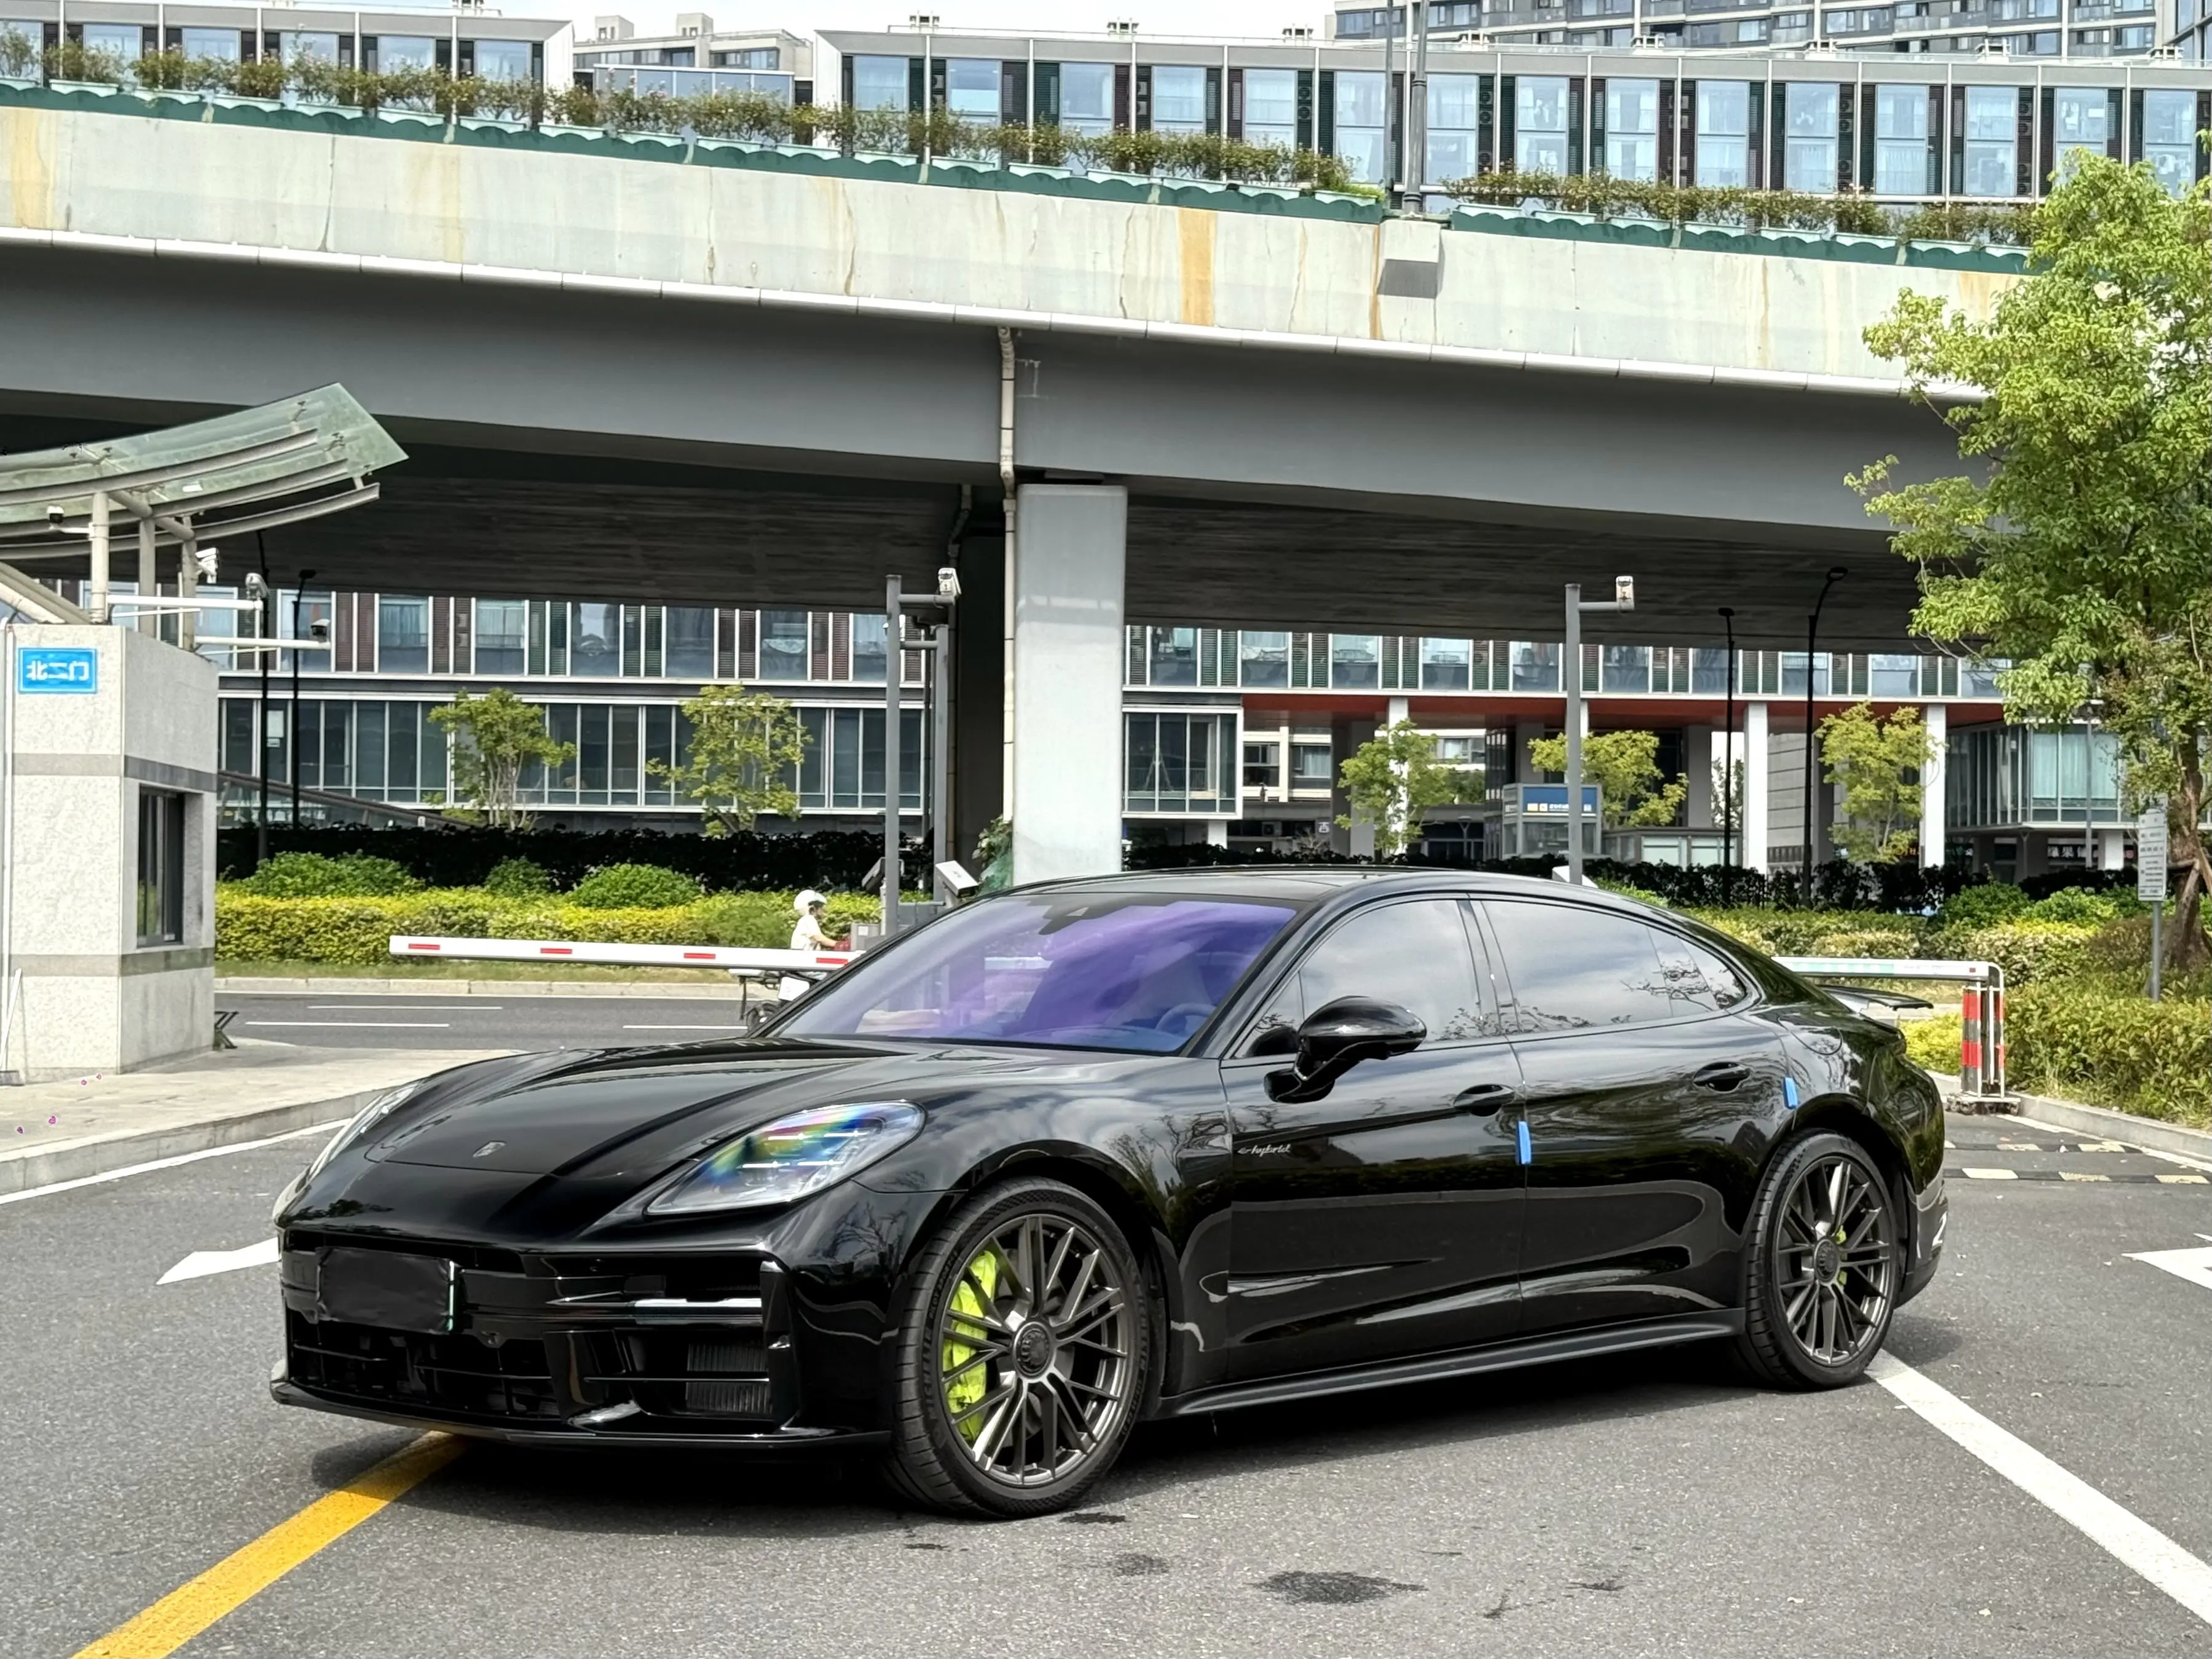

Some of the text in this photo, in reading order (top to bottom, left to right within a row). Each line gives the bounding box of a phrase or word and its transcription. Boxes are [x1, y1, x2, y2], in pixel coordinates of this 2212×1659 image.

[26, 660, 90, 681] 北二门
[1237, 1144, 1291, 1157] e-hybrid
